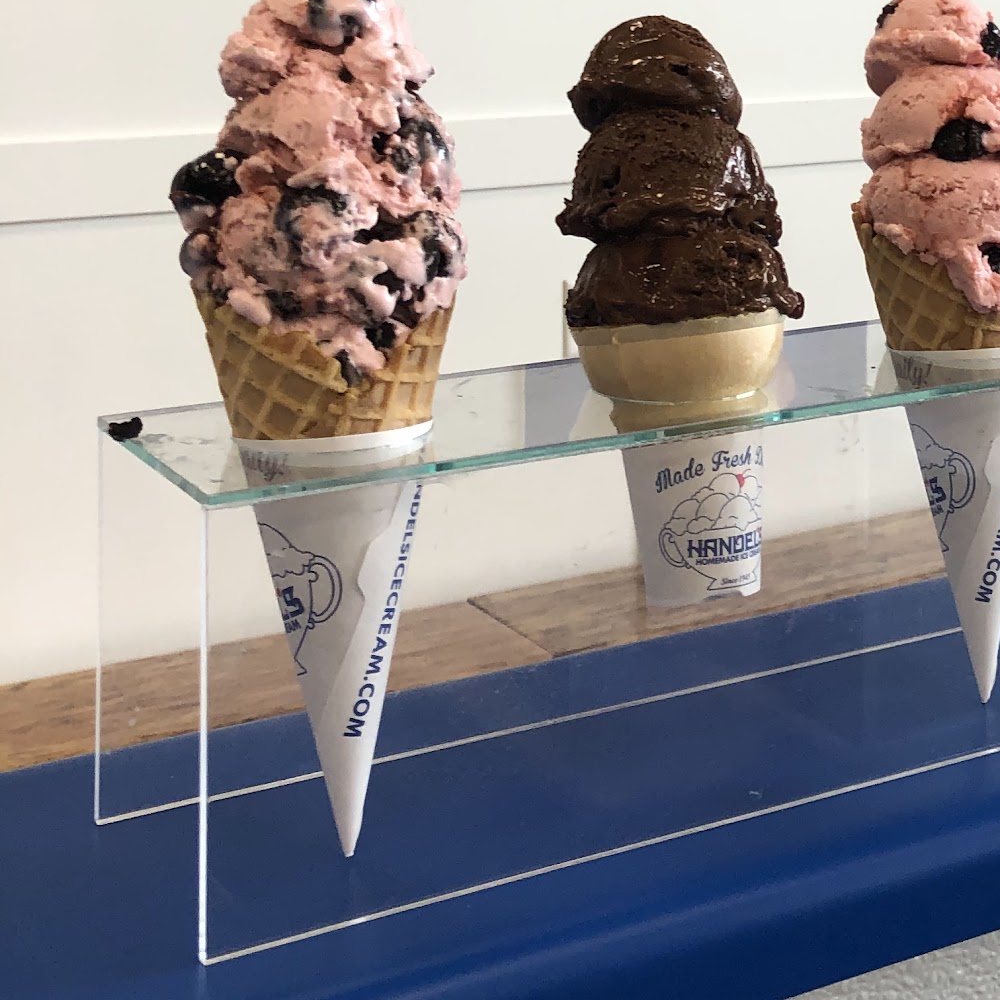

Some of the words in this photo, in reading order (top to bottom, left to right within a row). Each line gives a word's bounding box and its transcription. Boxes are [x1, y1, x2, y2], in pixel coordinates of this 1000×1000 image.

[655, 458, 705, 493] Made
[711, 445, 752, 473] Fresh
[344, 484, 424, 739] NDELSICECREAM.COM
